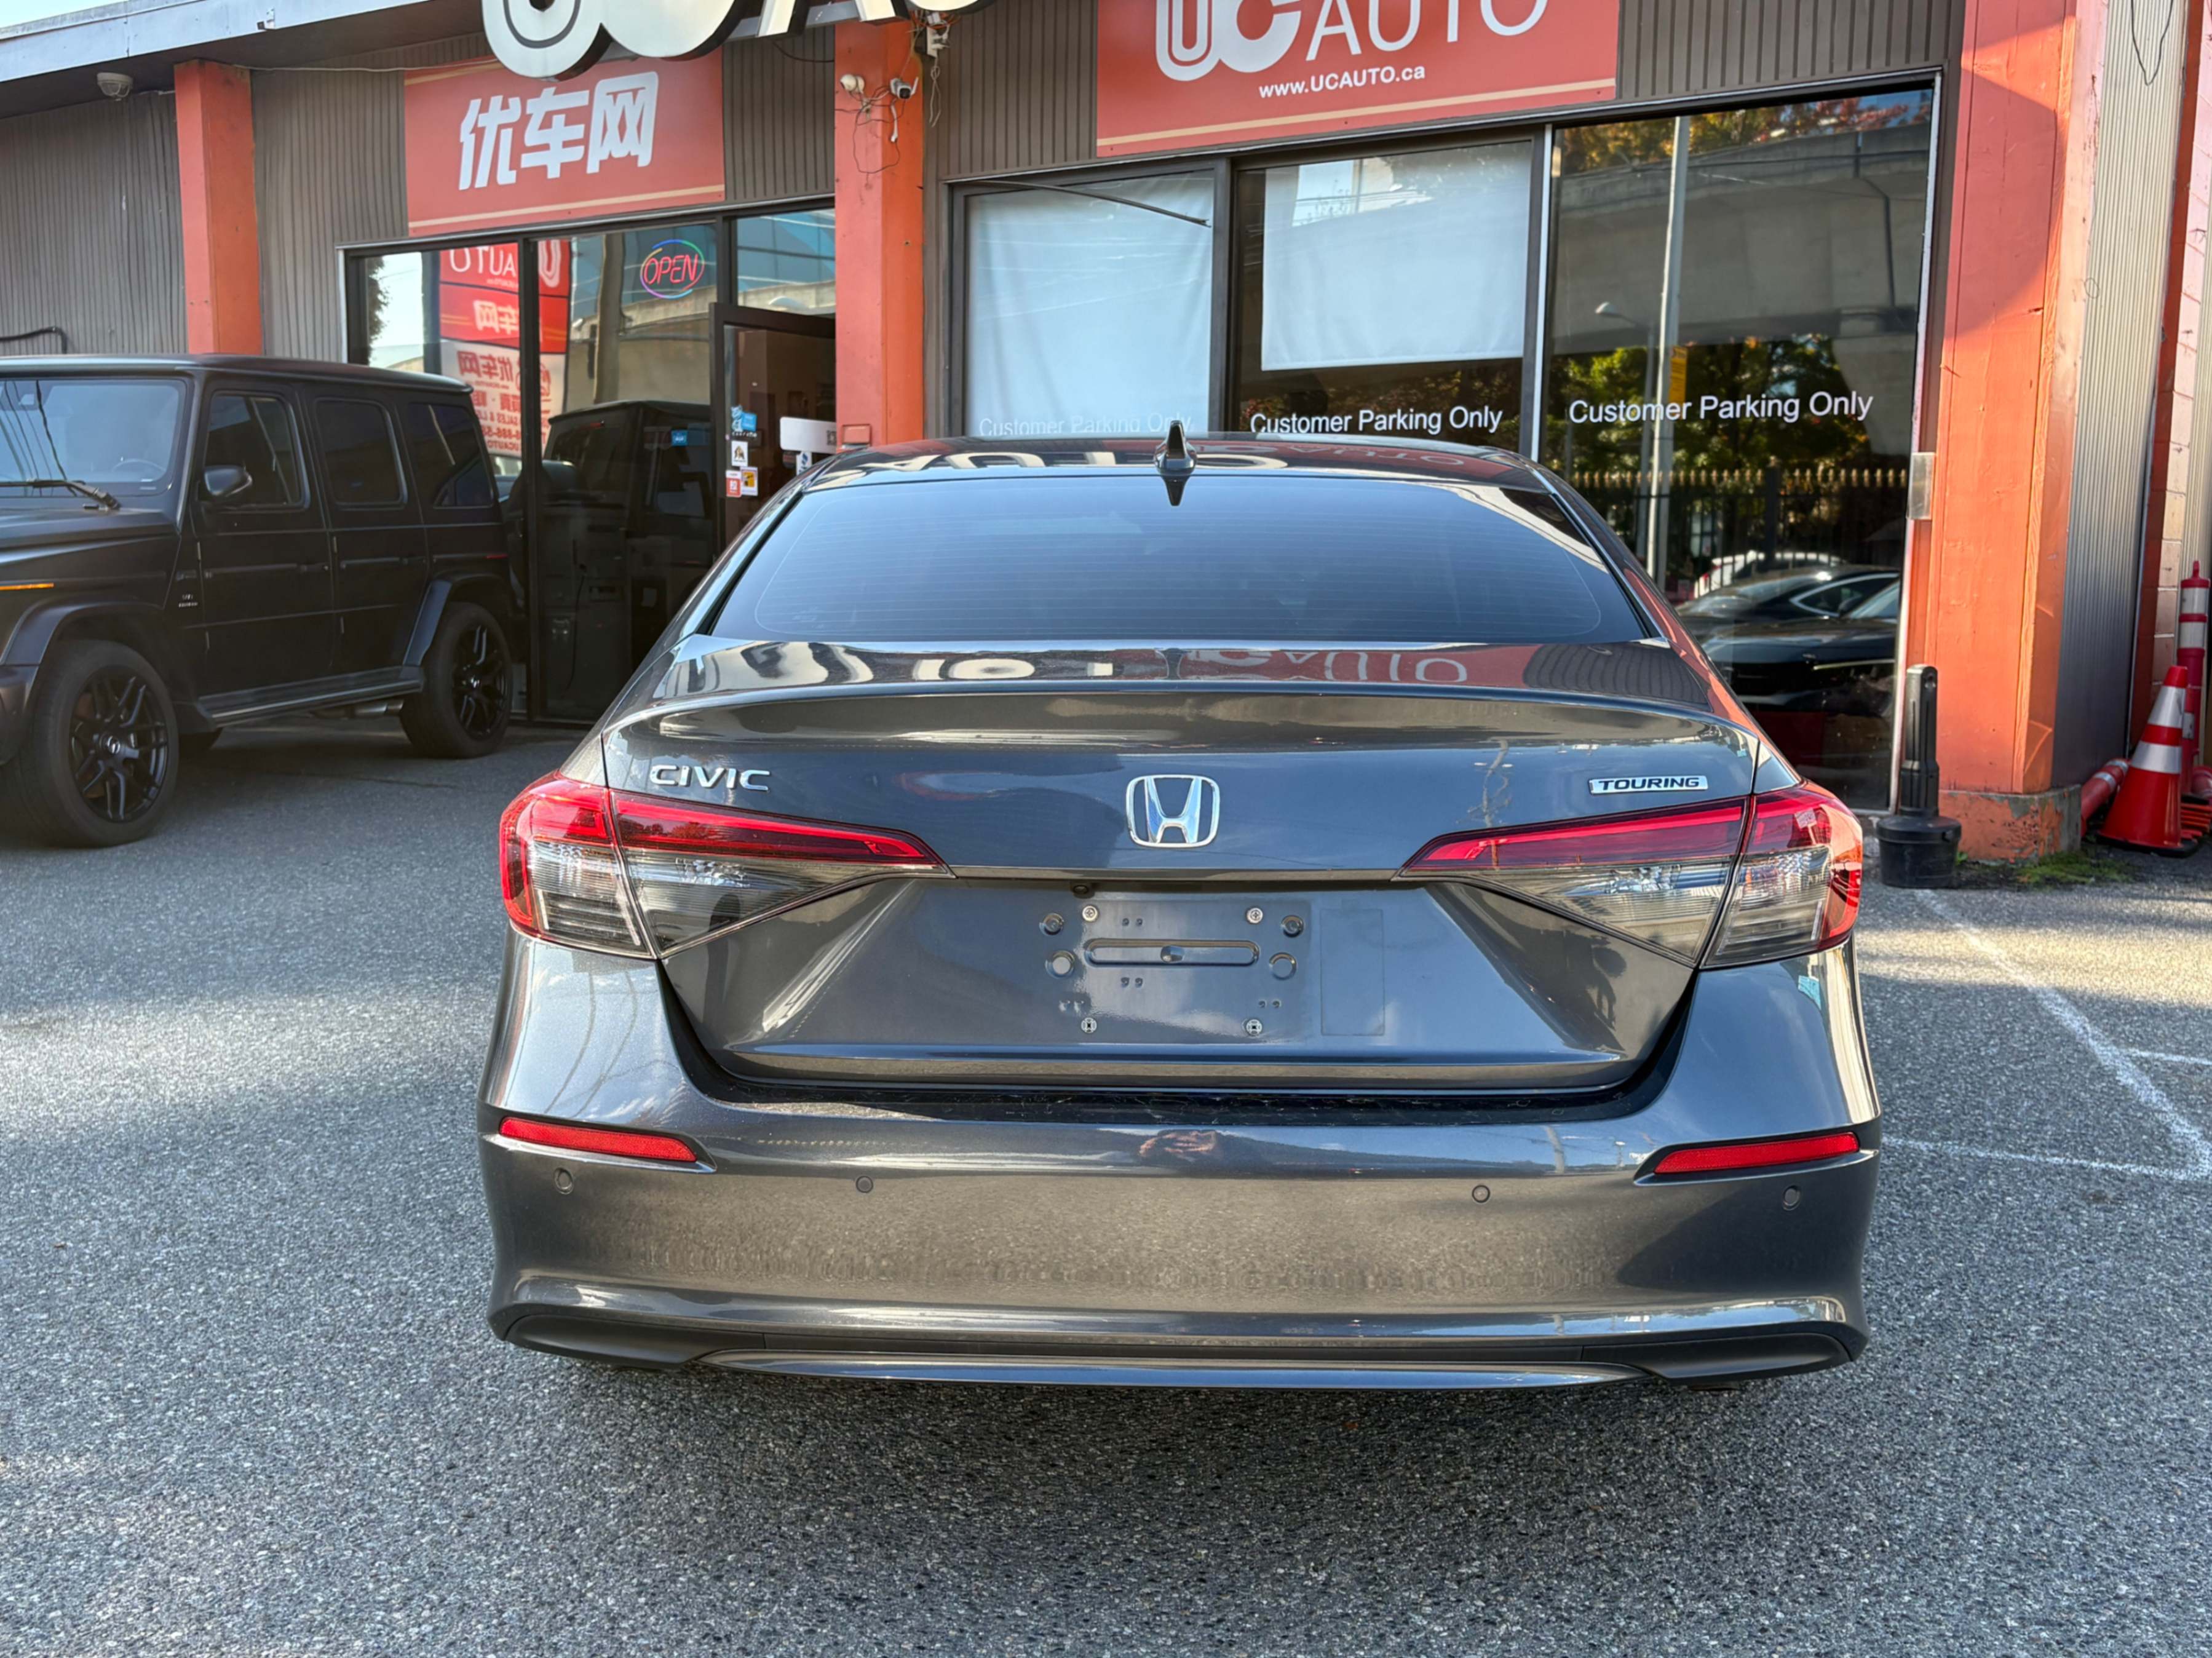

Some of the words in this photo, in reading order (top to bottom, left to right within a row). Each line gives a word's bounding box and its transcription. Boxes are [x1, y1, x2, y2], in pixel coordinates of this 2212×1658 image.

[1258, 65, 1426, 98] www.UCAUTO.ca
[459, 71, 659, 191] 优车网
[643, 253, 699, 285] OPEN
[1250, 413, 1352, 433] Customer
[1358, 408, 1442, 435] Parking
[1449, 405, 1503, 433] Only
[1569, 399, 1692, 424] Customer
[1700, 394, 1800, 423] Parking
[1809, 390, 1874, 421] Only
[979, 418, 1064, 437] Customer
[649, 764, 770, 791] CIVIC
[1598, 777, 1700, 791] TOURING
